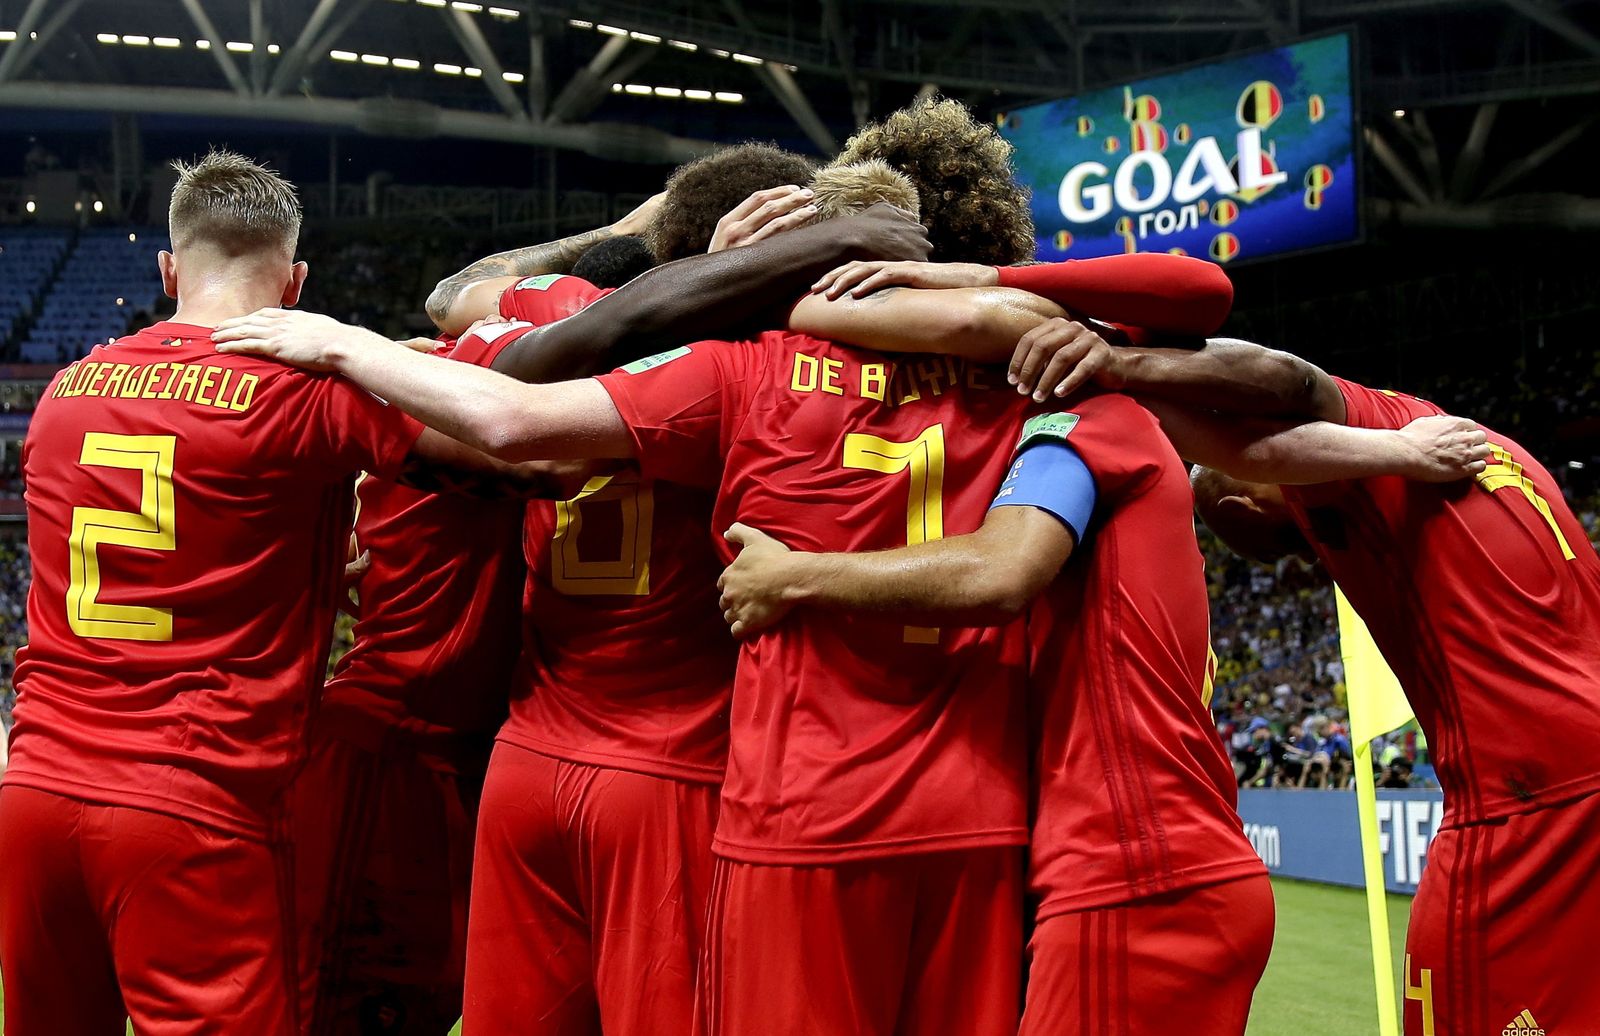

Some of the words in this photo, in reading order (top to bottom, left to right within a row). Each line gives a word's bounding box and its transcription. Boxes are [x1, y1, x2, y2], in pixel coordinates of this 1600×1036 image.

[1058, 127, 1288, 223] GOAL
[52, 362, 260, 412] ALDERWEIRELD
[790, 352, 844, 395] DE
[66, 432, 177, 642] 2
[842, 423, 945, 644] 7
[1376, 800, 1443, 885] FIF
[1501, 1026, 1546, 1036] adidas
